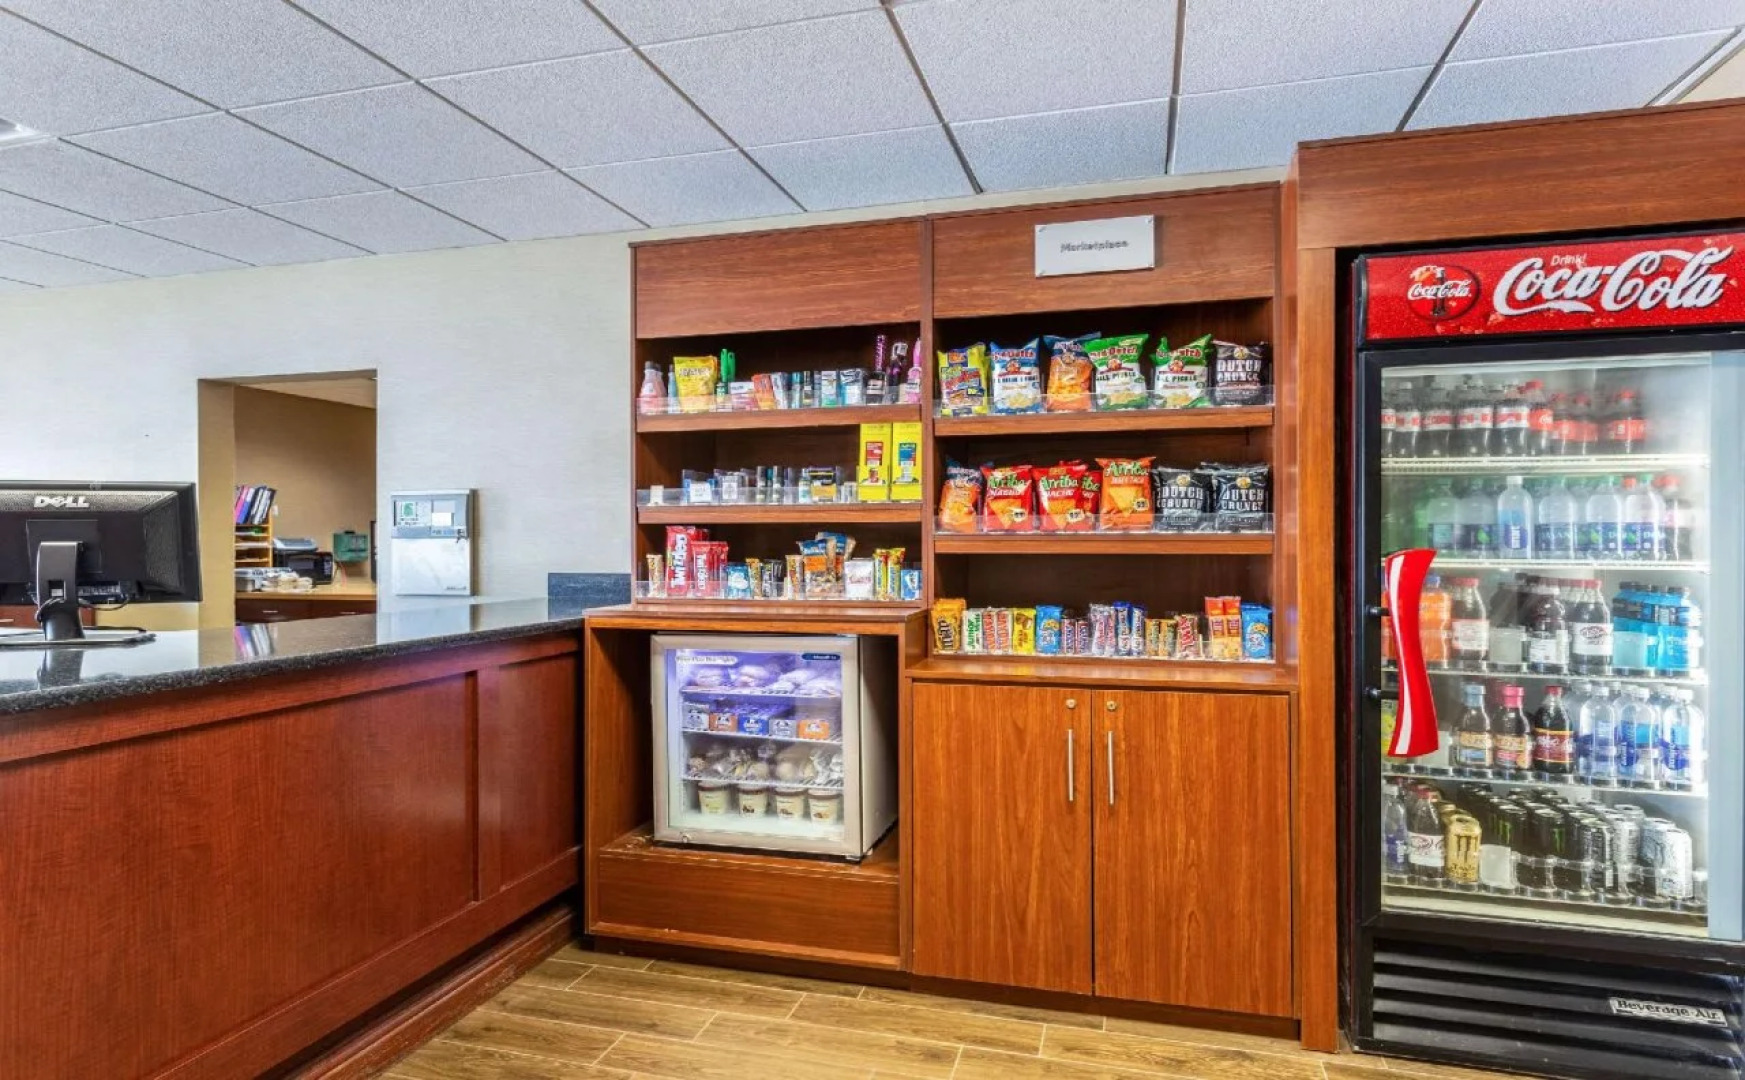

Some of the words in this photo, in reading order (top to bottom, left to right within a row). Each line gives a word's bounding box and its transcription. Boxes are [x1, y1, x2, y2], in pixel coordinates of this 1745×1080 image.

[1060, 240, 1128, 253] Marketplace
[1494, 245, 1733, 316] Coca-Cola
[1407, 280, 1472, 300] Coca-Cola
[33, 495, 90, 508] DELL
